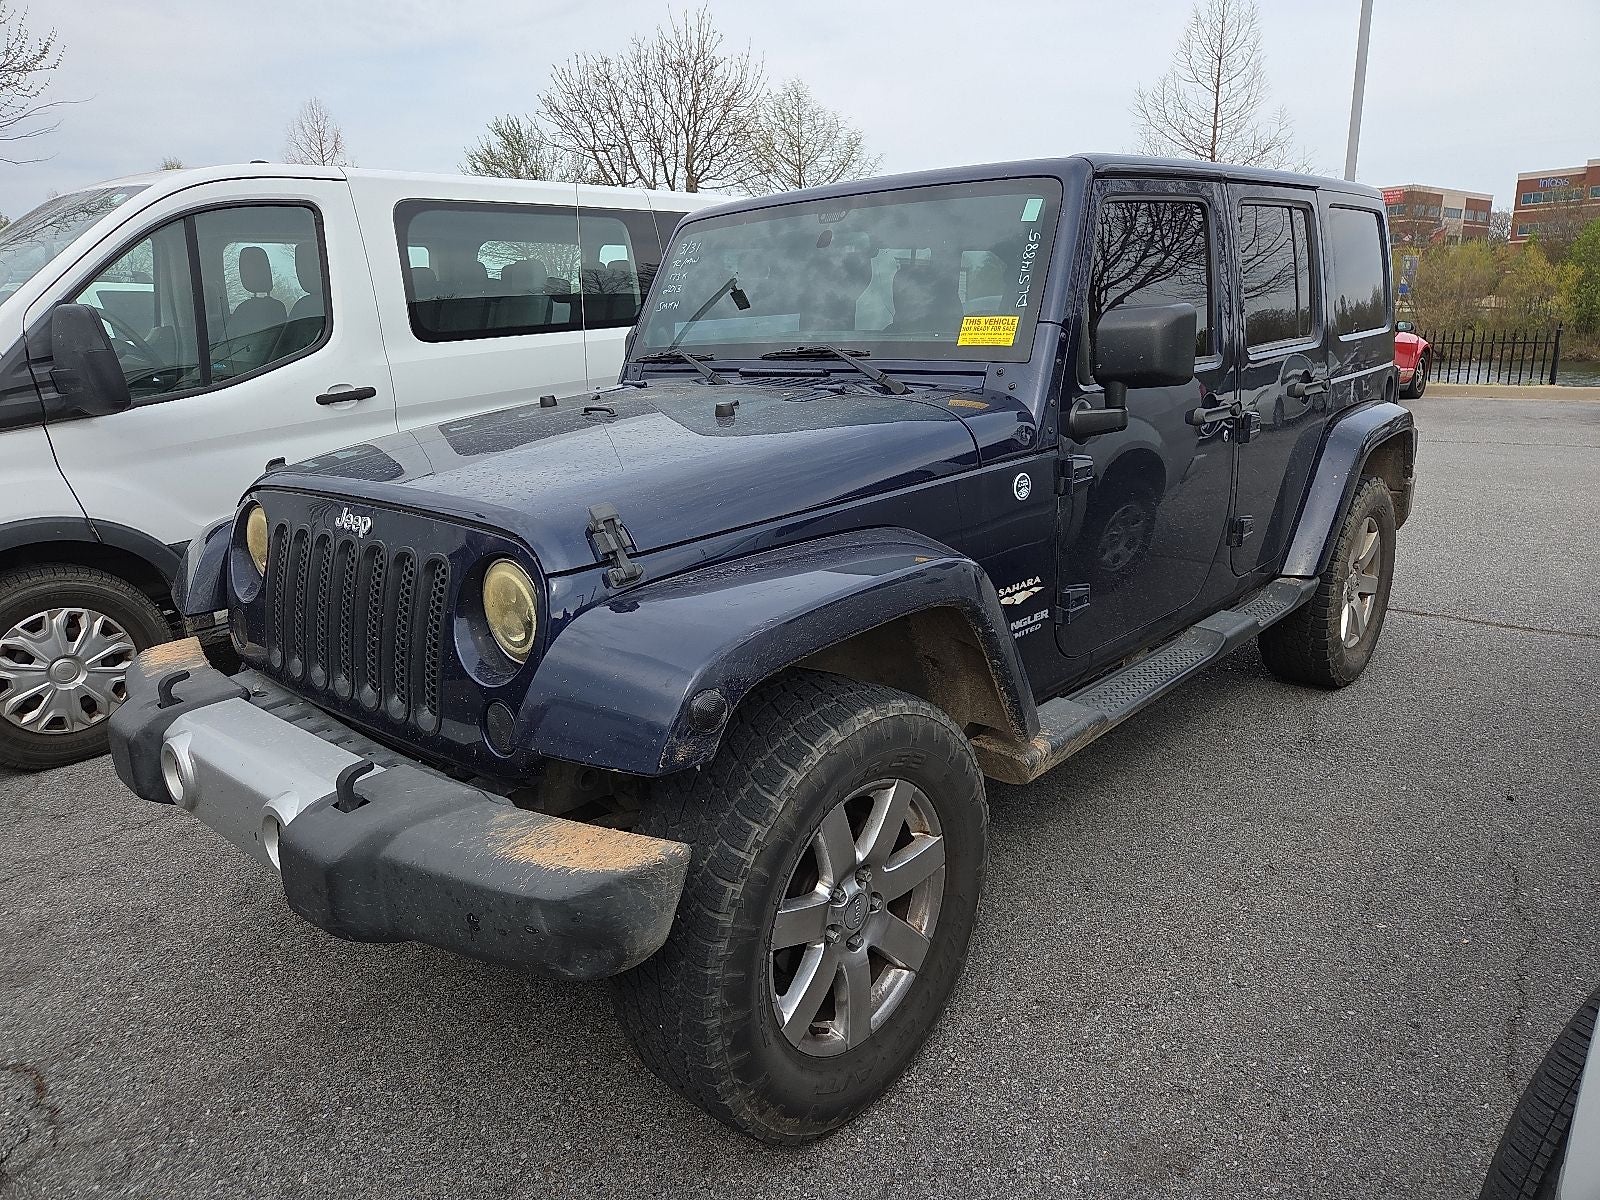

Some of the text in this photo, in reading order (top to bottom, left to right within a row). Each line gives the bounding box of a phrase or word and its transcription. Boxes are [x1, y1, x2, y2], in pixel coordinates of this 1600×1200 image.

[680, 240, 702, 256] 3/31
[965, 318, 1017, 326] THIS VEHICLE
[335, 507, 372, 539] Jeep
[998, 575, 1042, 598] SAHARA
[1010, 608, 1050, 631] NGLER
